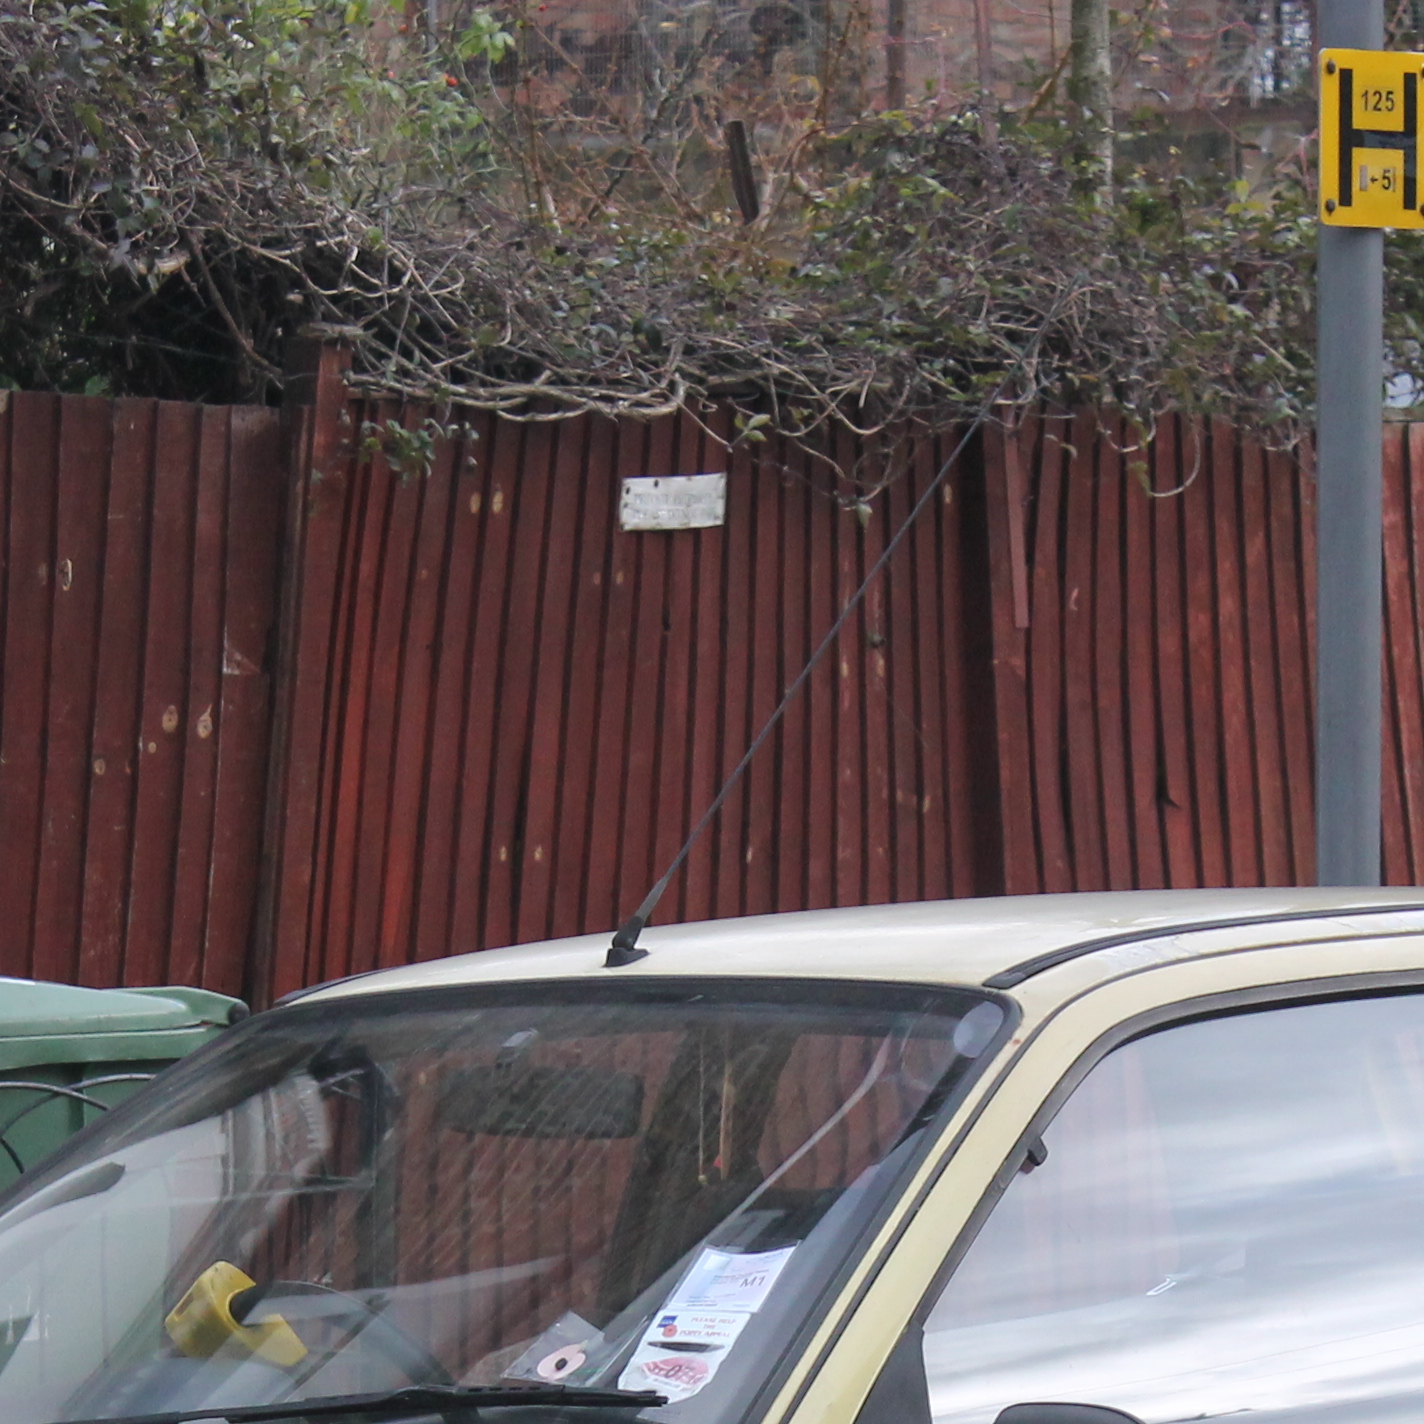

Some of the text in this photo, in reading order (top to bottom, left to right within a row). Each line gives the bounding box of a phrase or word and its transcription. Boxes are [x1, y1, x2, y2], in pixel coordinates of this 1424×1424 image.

[1361, 90, 1395, 112] 125
[1339, 68, 1417, 210] H
[1381, 169, 1392, 190] 5
